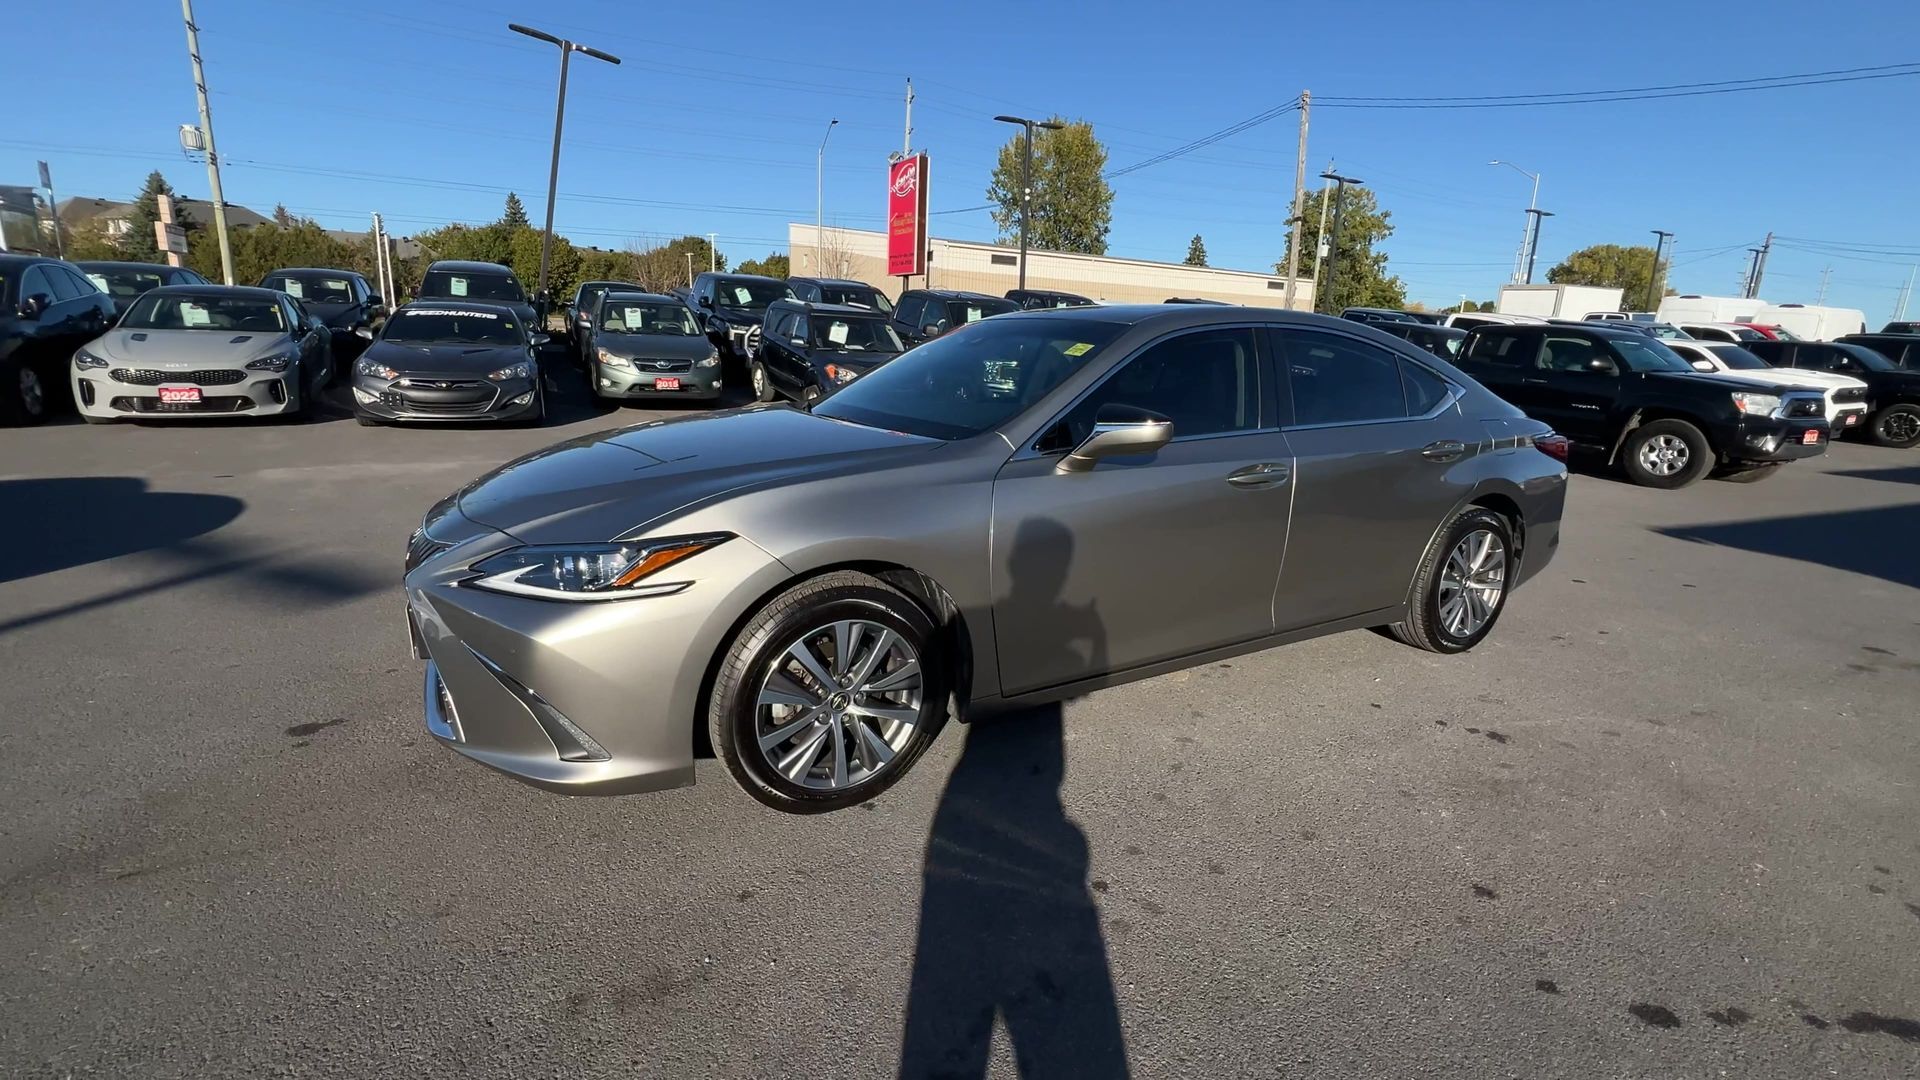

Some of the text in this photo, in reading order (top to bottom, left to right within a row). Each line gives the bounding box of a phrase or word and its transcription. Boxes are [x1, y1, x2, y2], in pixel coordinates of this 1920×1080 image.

[406, 310, 498, 320] SPEEDHUNTERS
[656, 380, 679, 388] 2015
[161, 391, 200, 401] 2022
